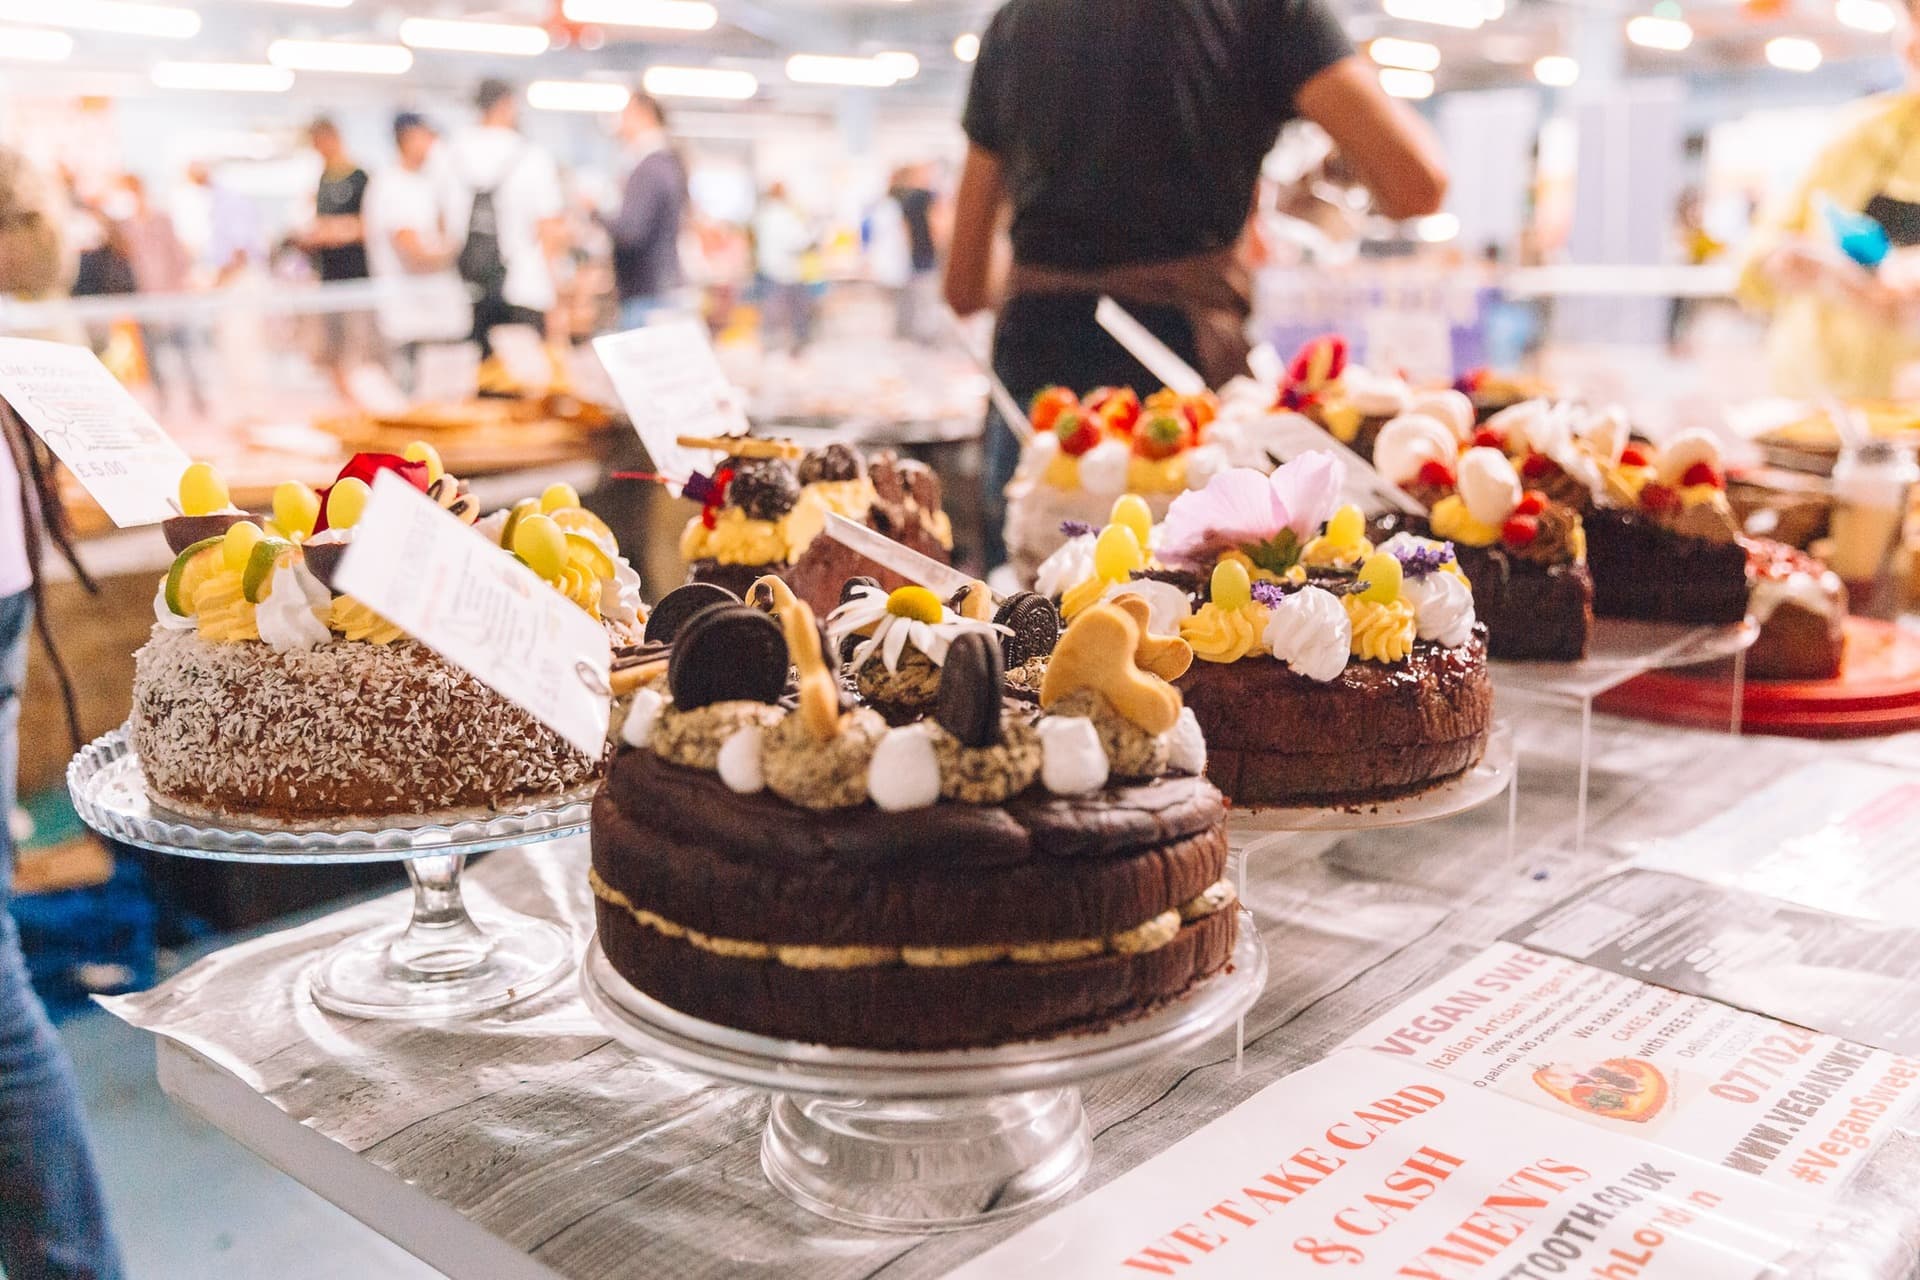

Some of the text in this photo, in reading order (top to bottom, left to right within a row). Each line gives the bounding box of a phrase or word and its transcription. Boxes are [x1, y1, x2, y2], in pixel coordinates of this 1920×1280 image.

[1371, 990, 1492, 1056] VEGAN
[1426, 1034, 1483, 1070] Italian
[1474, 1003, 1528, 1037] Artisan
[1570, 1023, 1599, 1040] We
[1590, 1006, 1625, 1025] take
[1610, 1015, 1653, 1042] CAKES
[1636, 1036, 1667, 1057] with
[1657, 1017, 1693, 1038] FREE
[1486, 1061, 1515, 1082] palm
[1517, 1039, 1539, 1053] NO
[1721, 1040, 1875, 1175] WWW.VEGANSWE
[1122, 1084, 1446, 1276] WE TAKE CARD
[1293, 1146, 1465, 1265] & CASH
